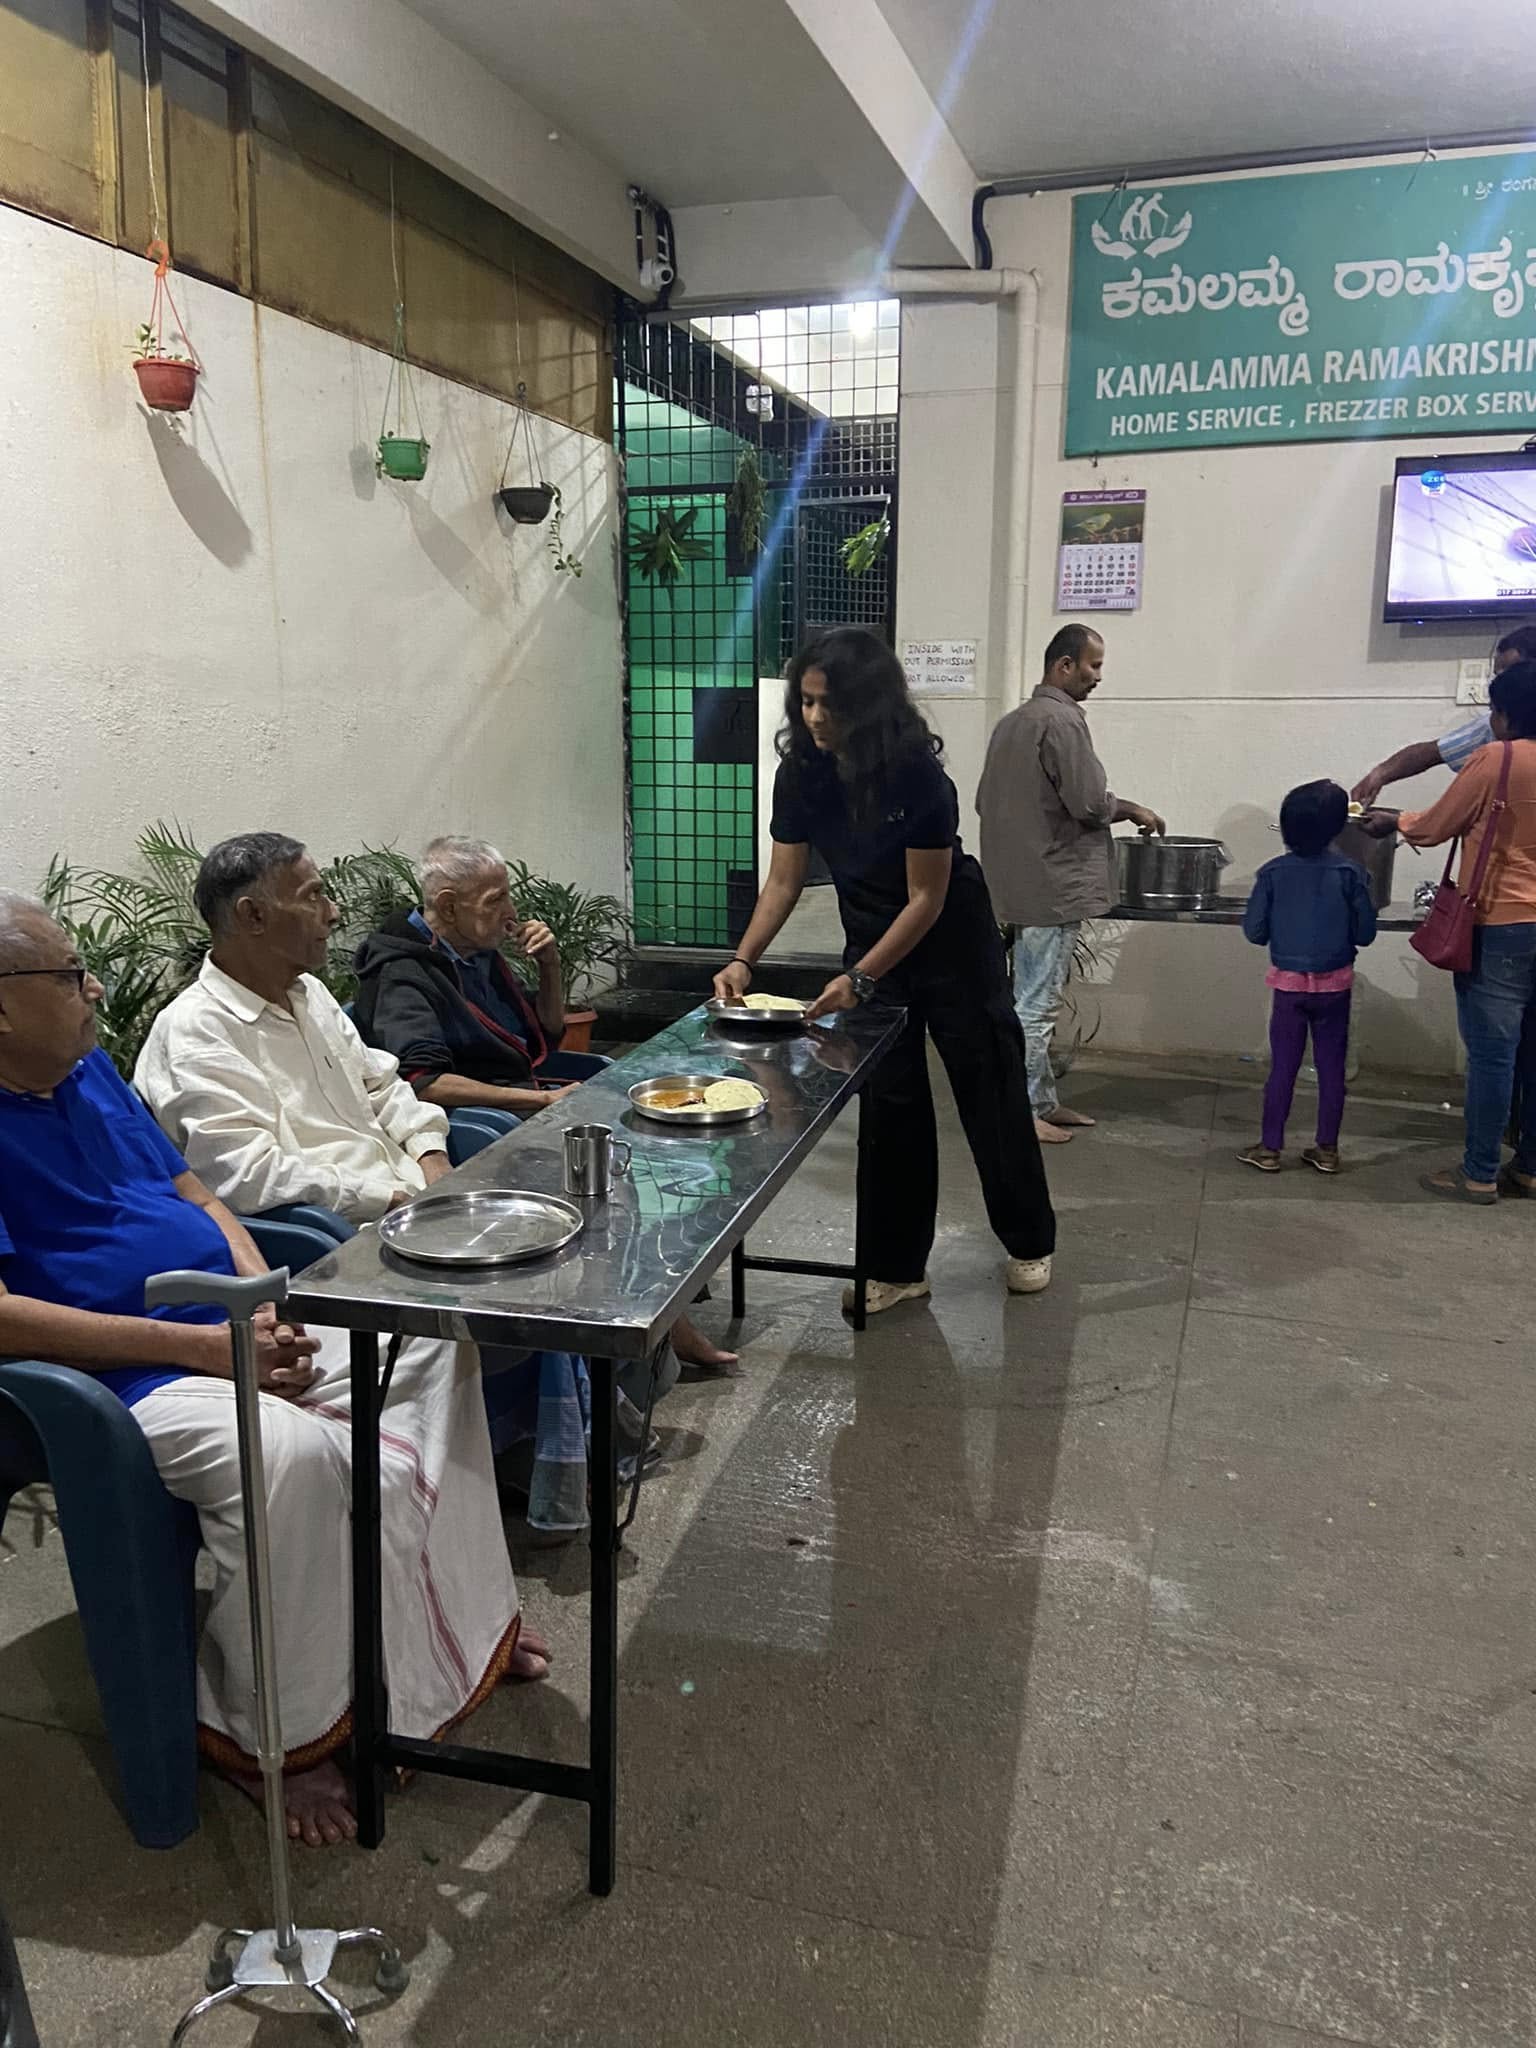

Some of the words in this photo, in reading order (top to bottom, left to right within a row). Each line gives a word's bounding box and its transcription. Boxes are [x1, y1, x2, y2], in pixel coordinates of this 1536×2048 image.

[1102, 255, 1310, 336] ಕಮಲಮ್ಮ
[1334, 236, 1536, 318] ರಾಮಕೃ
[1096, 353, 1312, 400] KAMALAMMA
[1111, 412, 1180, 437] HOME
[1305, 398, 1409, 424] FREZZER
[1417, 394, 1470, 418] BOX
[904, 657, 921, 666] OUT
[908, 645, 943, 654] INSIDE
[952, 645, 975, 654] WITH
